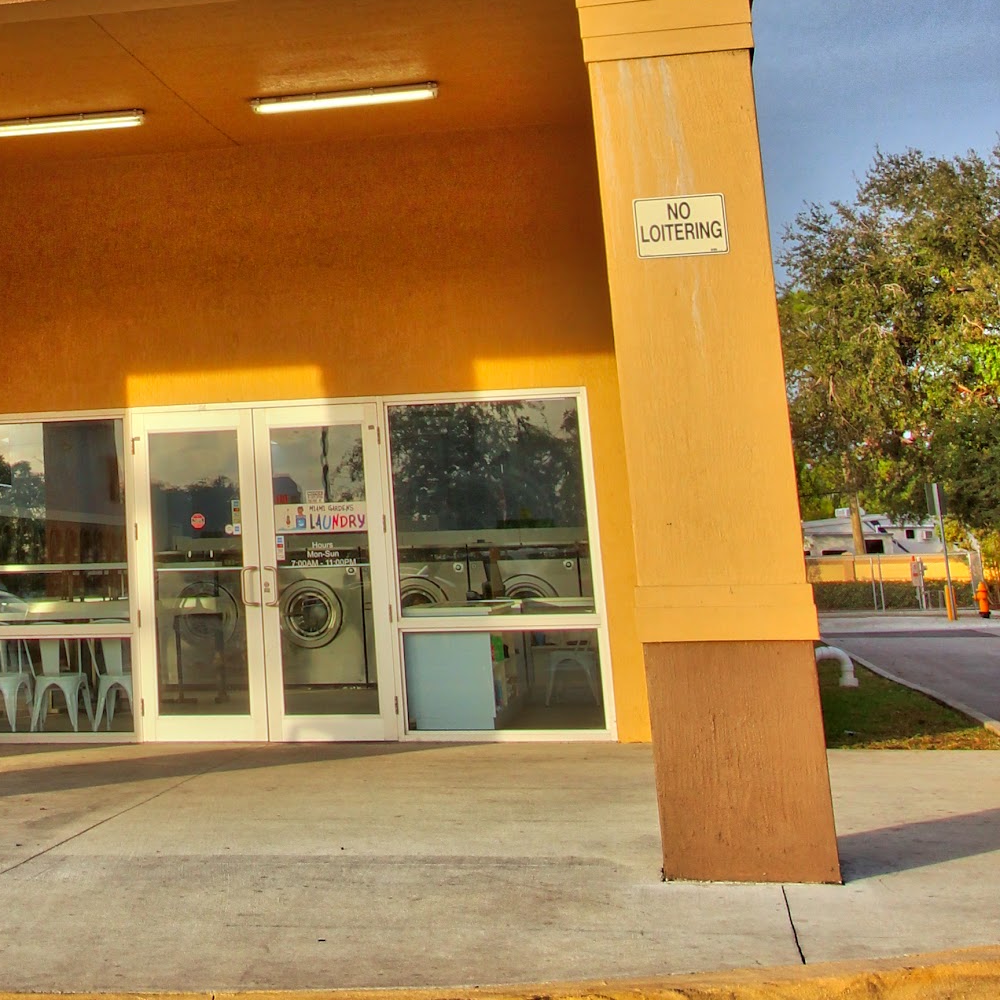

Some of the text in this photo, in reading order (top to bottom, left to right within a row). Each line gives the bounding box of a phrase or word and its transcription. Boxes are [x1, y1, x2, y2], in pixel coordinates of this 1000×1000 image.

[667, 202, 690, 220] NO
[640, 221, 722, 242] LOITERING
[327, 504, 354, 512] GARDENS
[310, 514, 365, 530] LAUNDRY
[326, 558, 357, 566] 11:00PM
